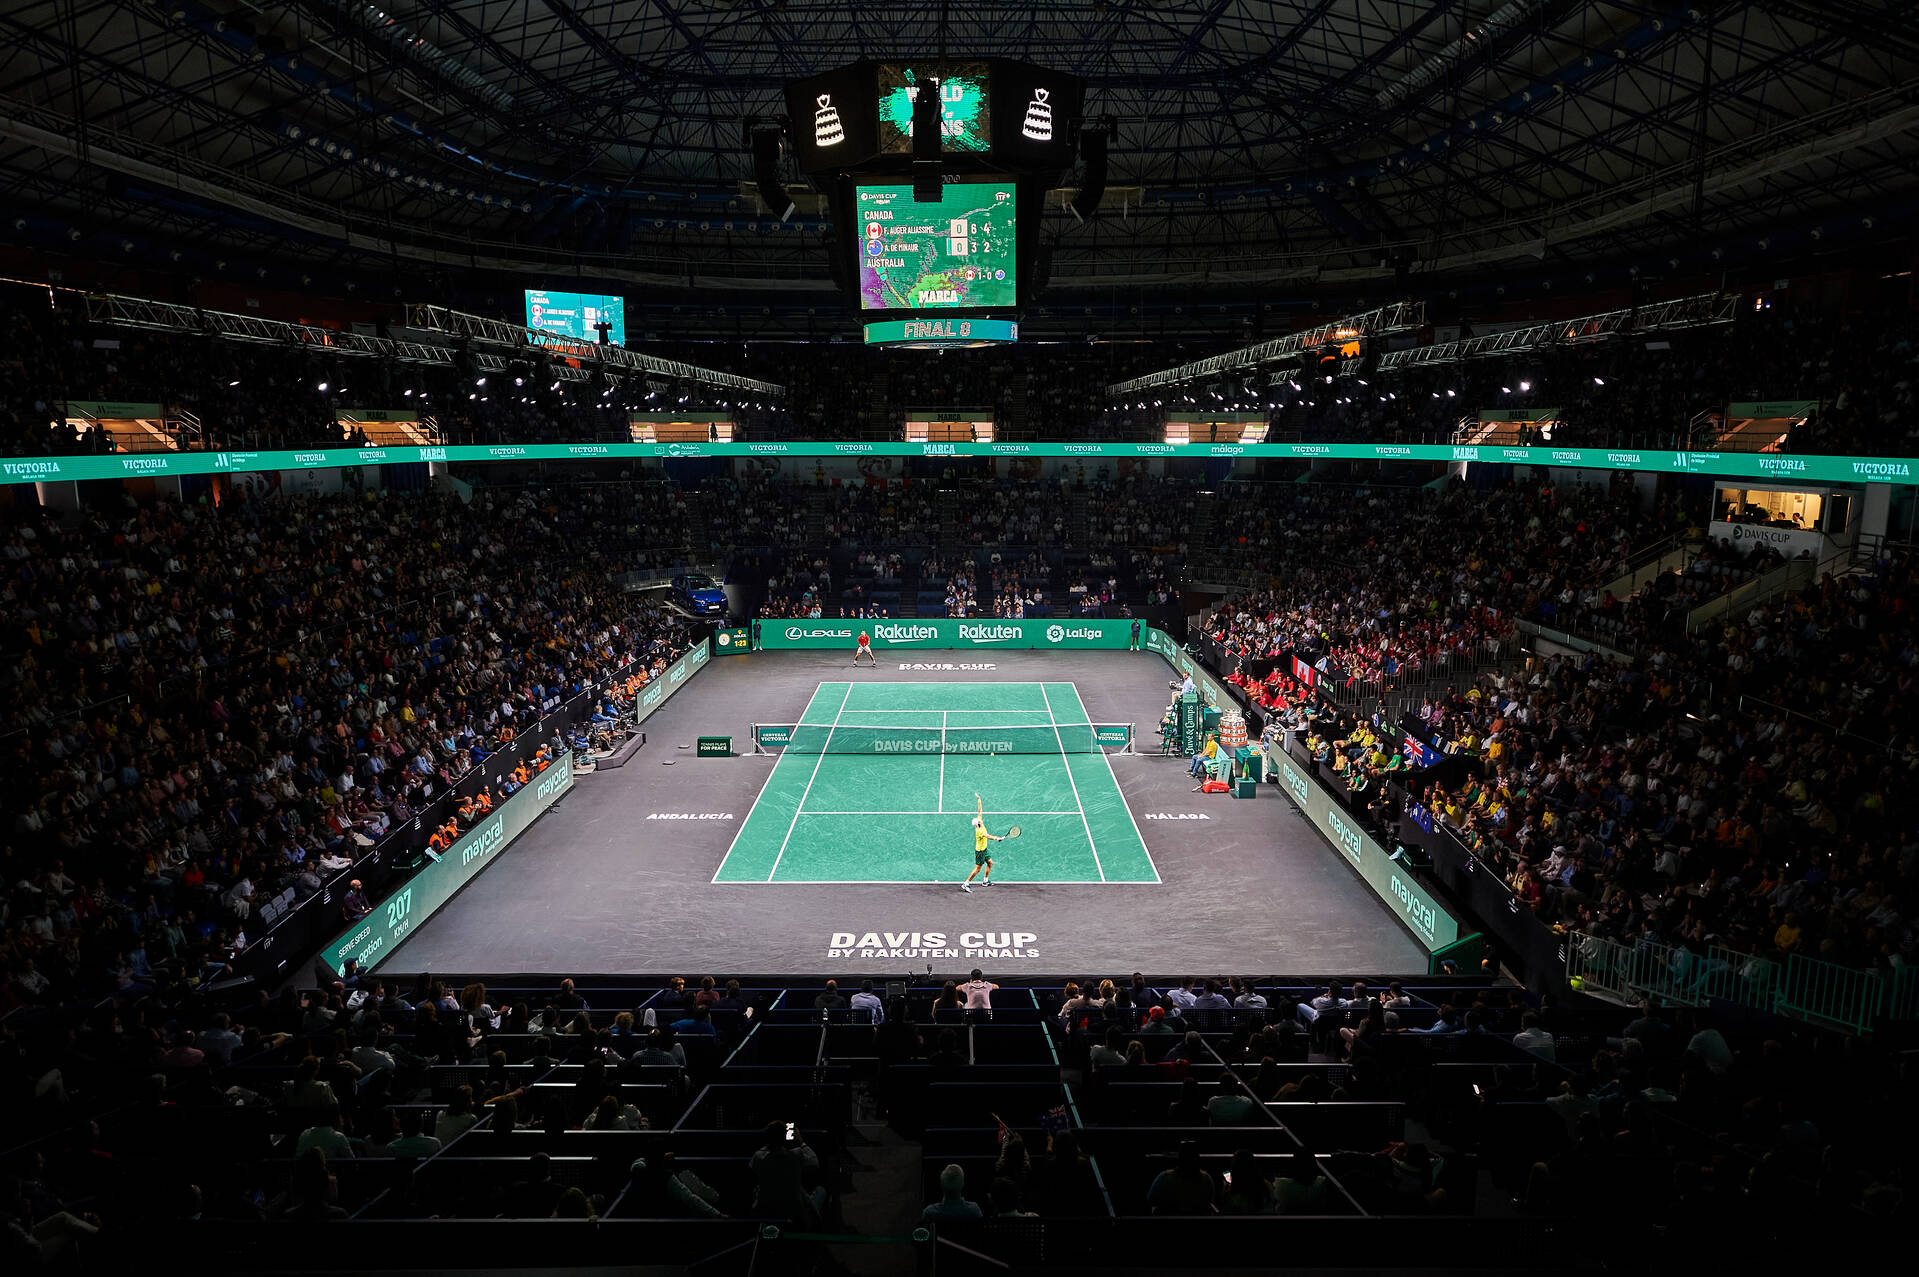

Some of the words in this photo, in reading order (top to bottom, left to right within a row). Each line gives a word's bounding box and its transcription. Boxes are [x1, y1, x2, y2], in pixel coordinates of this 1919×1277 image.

[864, 210, 894, 220] CANADA
[983, 223, 991, 234] 4
[983, 242, 990, 253] 2
[866, 258, 905, 268] AUSTRALIA
[918, 290, 959, 303] MARCA
[904, 321, 957, 338] FINAL
[959, 321, 971, 337] 8
[358, 450, 387, 459] VICTORIA
[419, 447, 447, 460] MARCA
[489, 447, 526, 455] VICTORIA
[569, 446, 608, 454] VICTORIA
[923, 444, 956, 455] MARCA
[1211, 444, 1244, 455] málaga
[1453, 447, 1479, 460] MARCA
[1503, 449, 1529, 458] VICTORIA
[1552, 451, 1582, 460] VICTORIA
[122, 458, 168, 469] VICTORIA
[294, 453, 326, 462] VICTORIA
[1607, 453, 1641, 463] VICTORIA
[3, 461, 61, 474] VICTORIA
[1759, 459, 1806, 470] VICTORIA
[1852, 462, 1910, 475] VICTORIA
[1744, 529, 1769, 541] DAVIS
[1770, 532, 1790, 543] CUP
[802, 629, 852, 638] LEXUS
[874, 624, 938, 639] Rakuten
[958, 624, 1023, 639] Rakuten
[1066, 628, 1103, 641] LaLiga
[874, 740, 913, 752] DAVIS
[914, 740, 941, 751] CUP
[945, 742, 958, 753] by
[959, 741, 1013, 752] RAKUTEN
[536, 760, 568, 800] mayoral
[1282, 763, 1308, 798] mayoral
[646, 812, 734, 820] ANDALUCÍA
[1328, 810, 1362, 855] mayoral
[462, 814, 504, 866] mayoral
[386, 887, 412, 929] 207
[1391, 874, 1436, 933] mayoral
[338, 938, 355, 958] SERVE
[354, 926, 371, 945] SPEED
[829, 932, 947, 948] DAVIS
[959, 932, 1038, 948] CUP
[358, 936, 383, 963] option
[827, 948, 857, 958] BY
[860, 948, 960, 958] RAKUTEN
[965, 948, 1041, 958] FINALS
